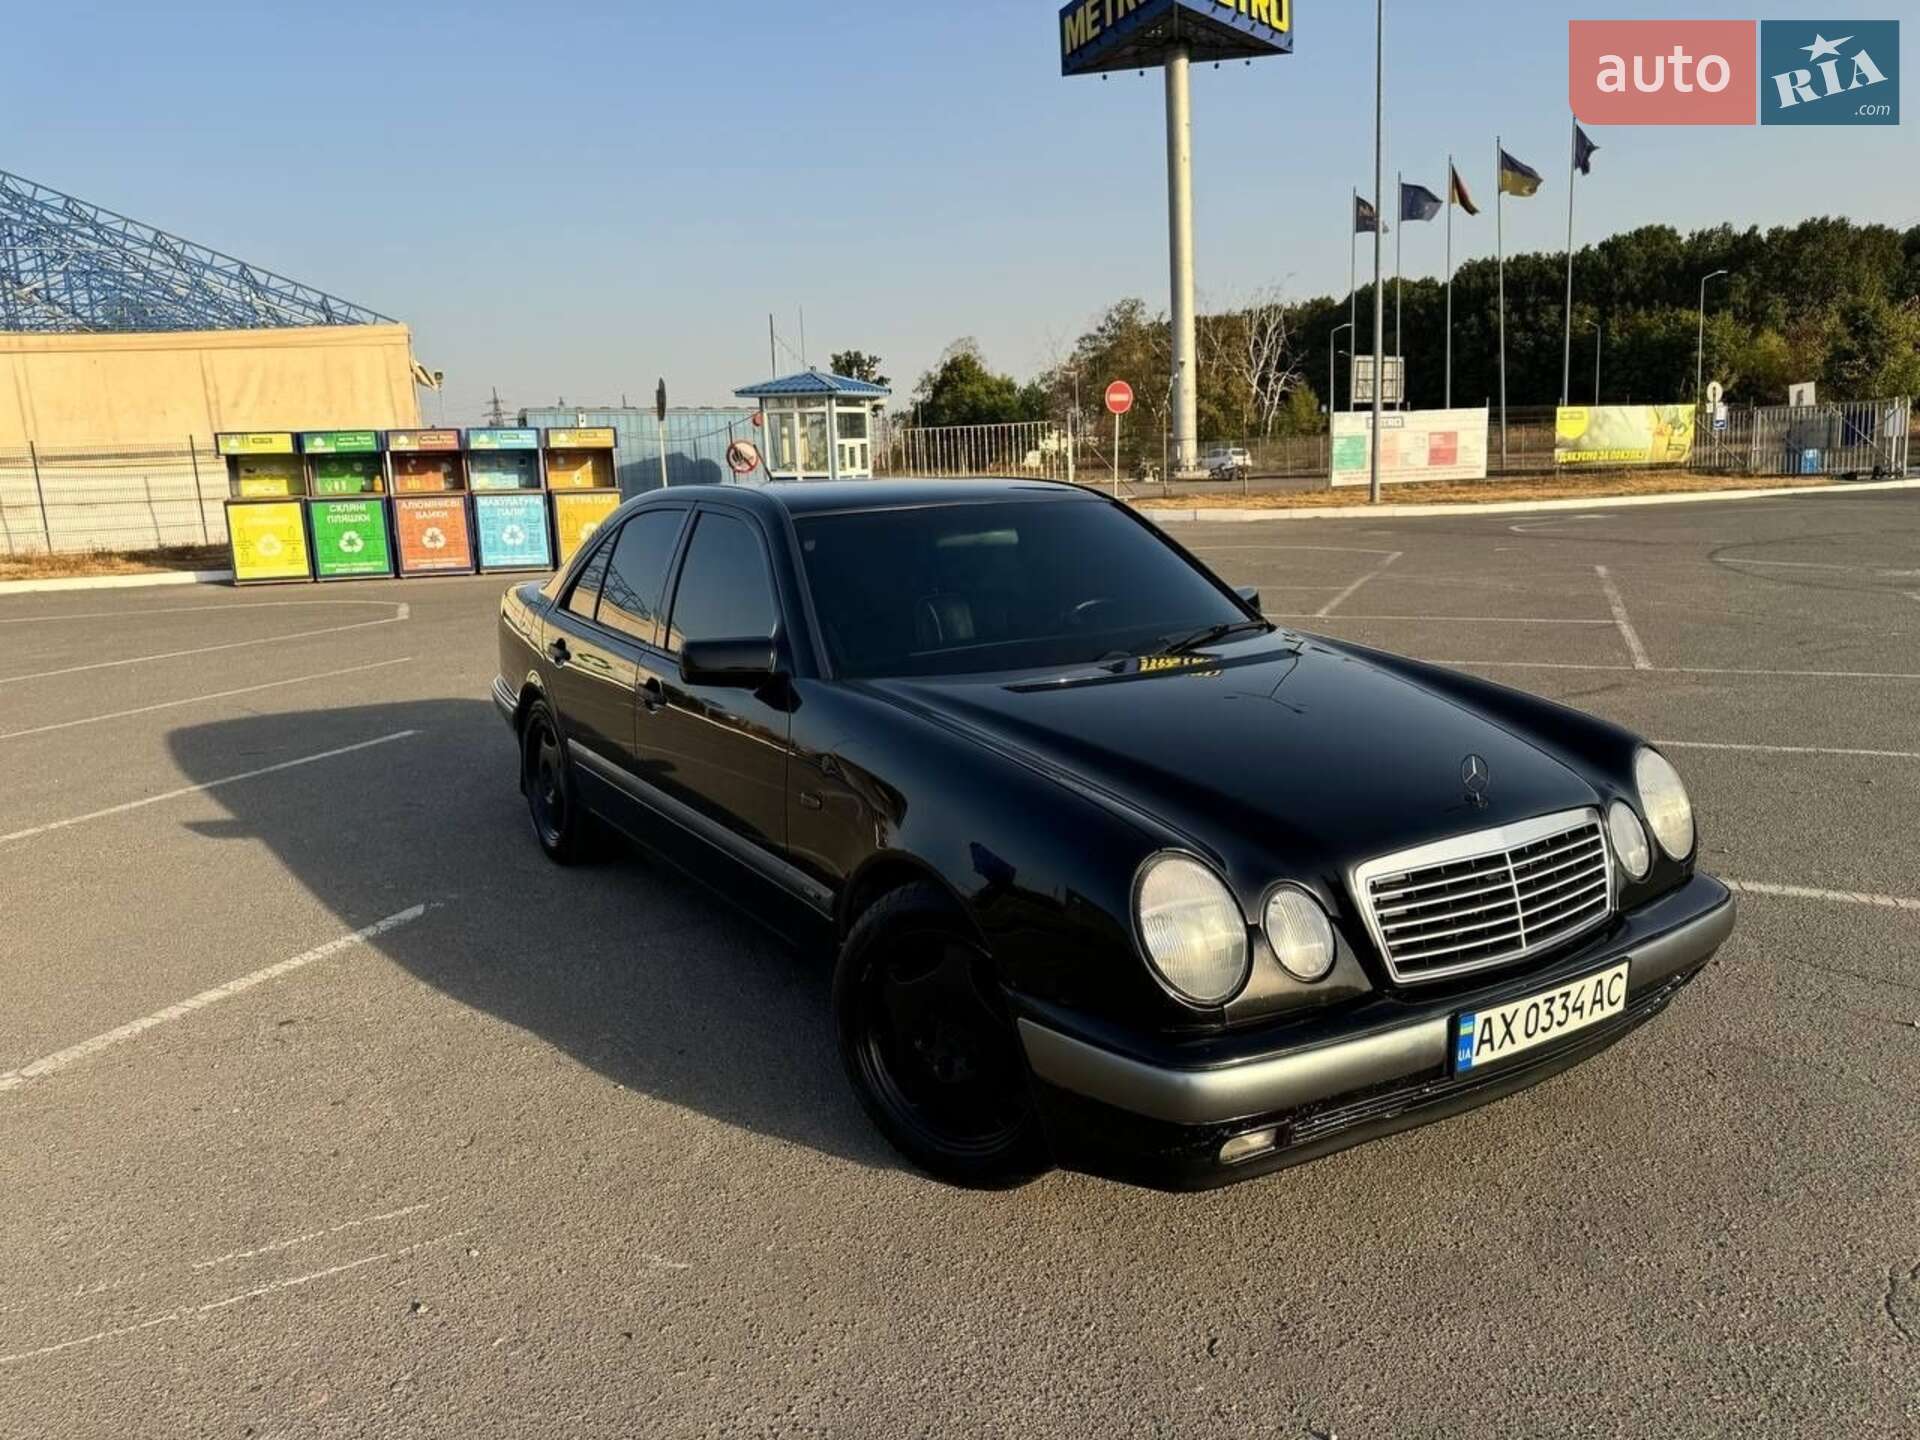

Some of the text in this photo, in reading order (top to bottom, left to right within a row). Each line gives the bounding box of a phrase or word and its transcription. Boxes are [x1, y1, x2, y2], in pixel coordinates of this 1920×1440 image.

[1064, 0, 1146, 55] MET
[1476, 972, 1623, 1056] AX 0334 AC
[1458, 1048, 1471, 1061] UA
